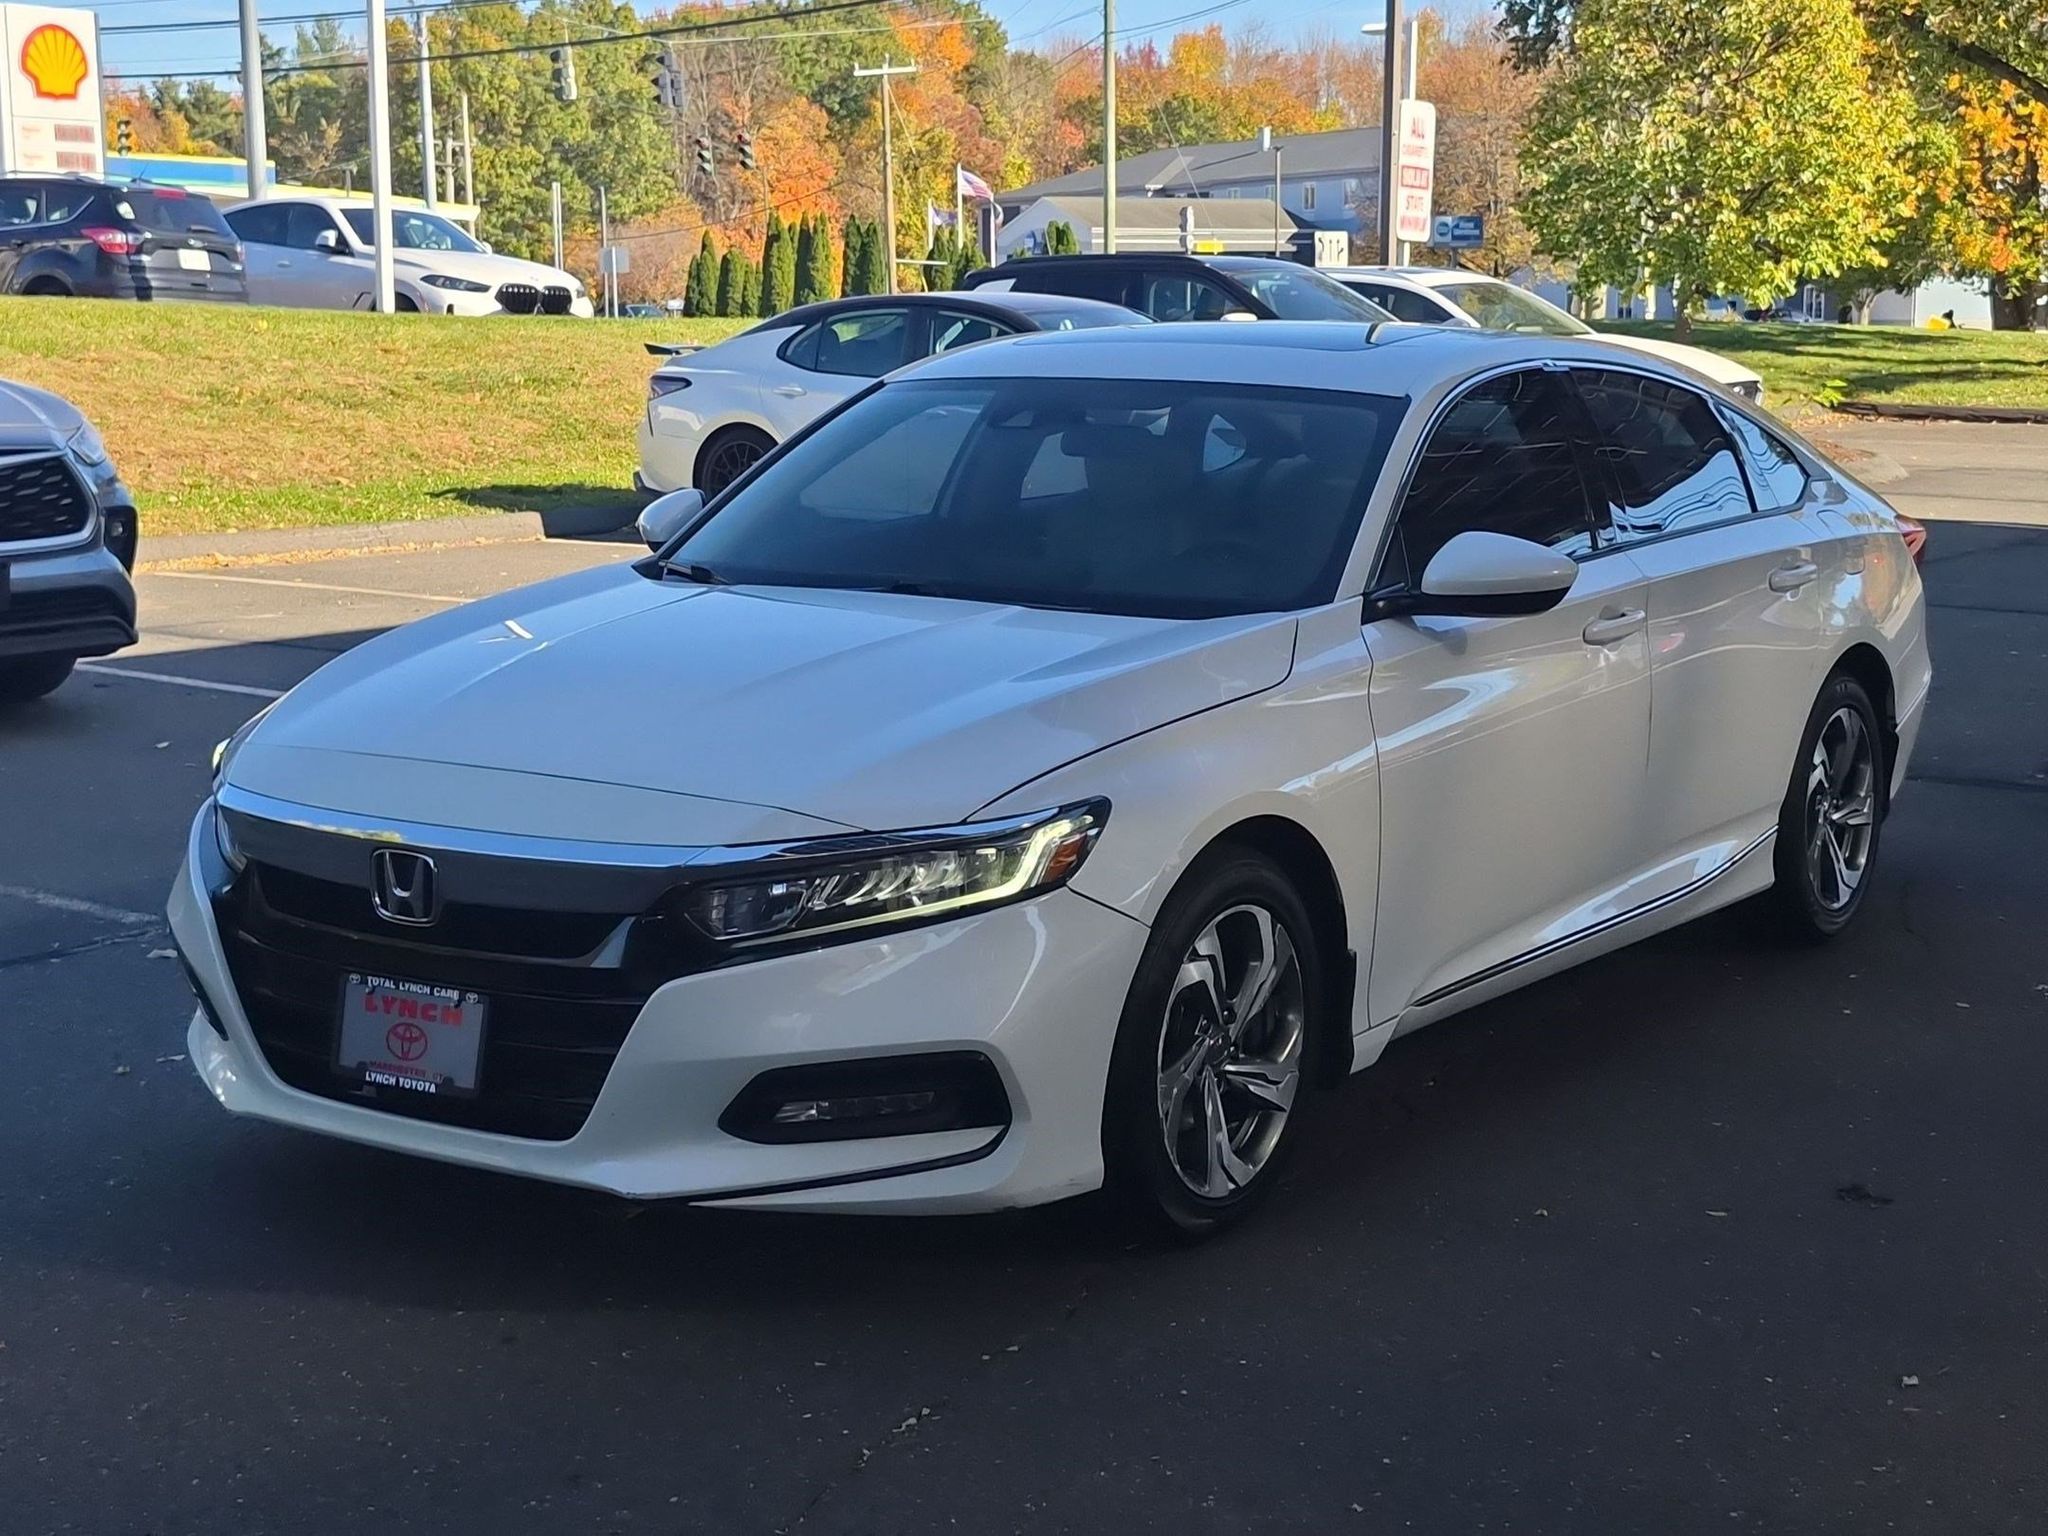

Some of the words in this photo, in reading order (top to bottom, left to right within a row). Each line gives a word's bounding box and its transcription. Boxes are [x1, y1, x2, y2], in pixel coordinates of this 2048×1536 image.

[1411, 117, 1425, 140] ALL
[367, 975, 395, 989] TOTAL
[399, 981, 430, 995] LYNCH
[363, 994, 463, 1026] LYNCH
[365, 1071, 396, 1087] LYNCH
[399, 1076, 436, 1093] TOYOTA
